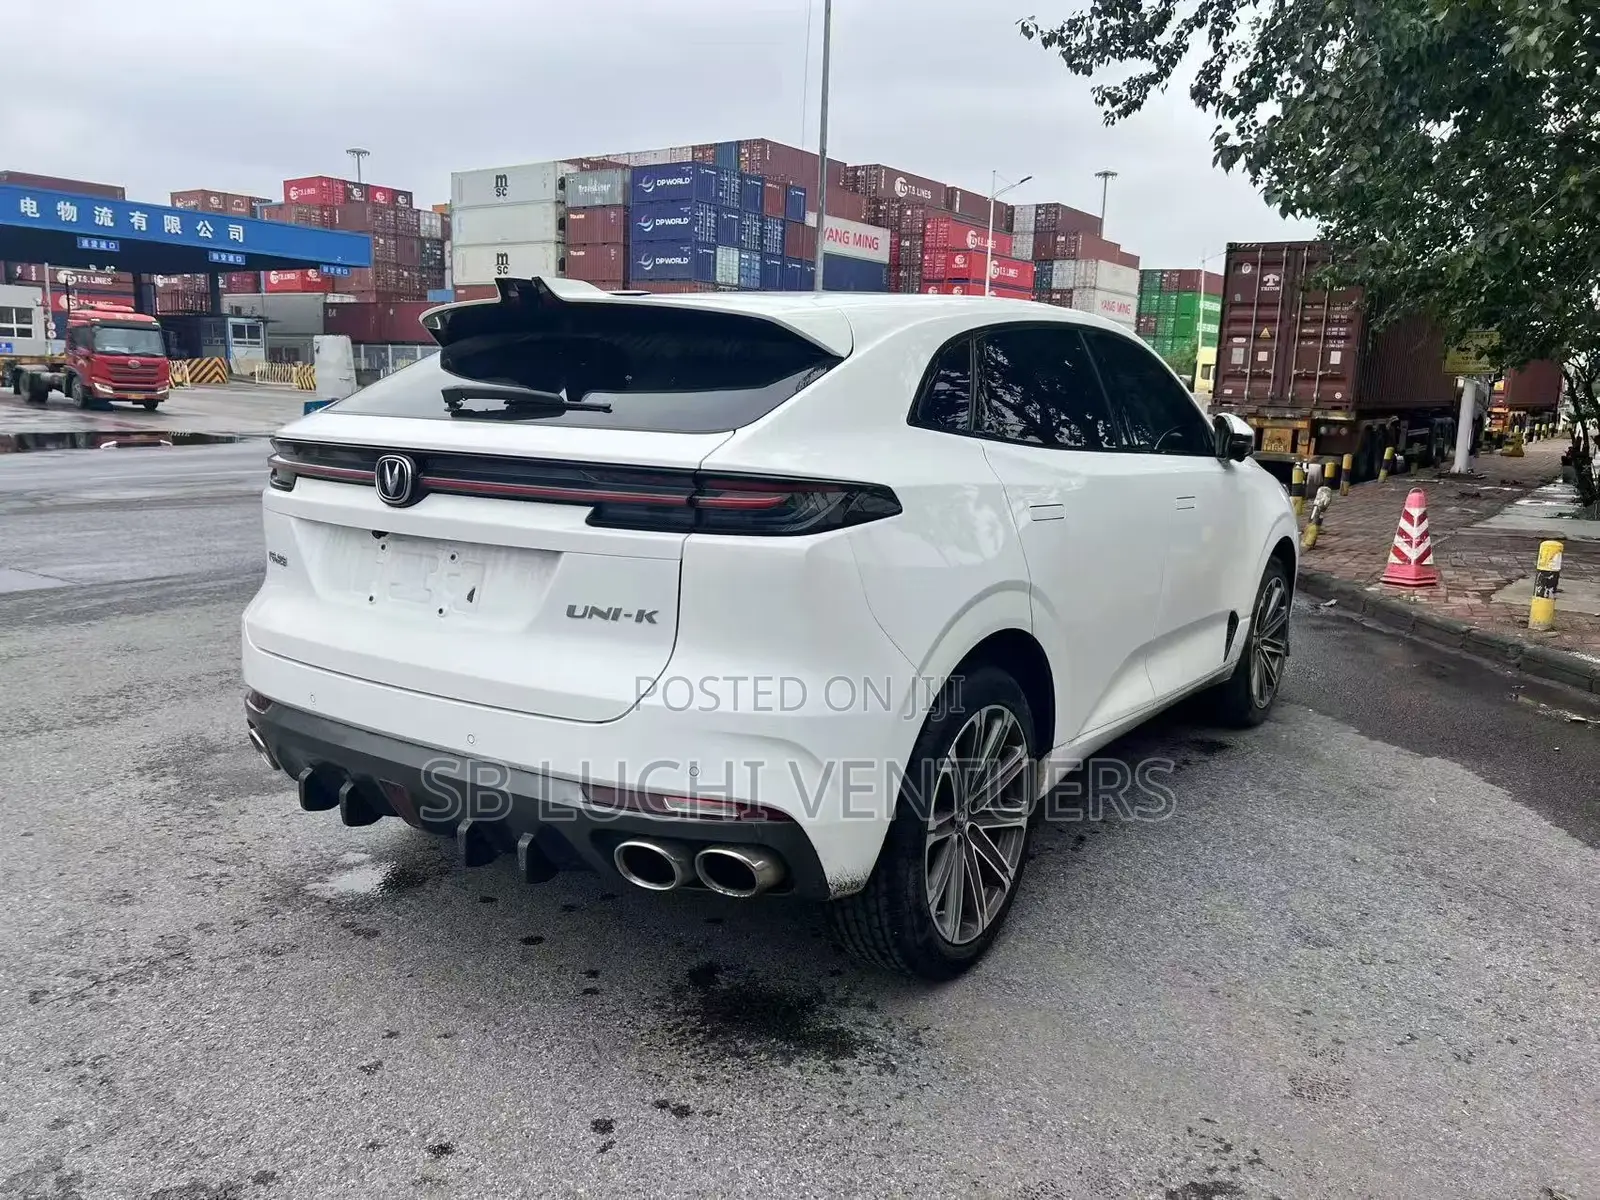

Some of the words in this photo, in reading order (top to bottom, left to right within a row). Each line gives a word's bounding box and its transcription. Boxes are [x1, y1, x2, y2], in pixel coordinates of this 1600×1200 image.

[20, 196, 244, 243] 电物流有限公司
[853, 232, 880, 250] MING
[91, 276, 113, 285] LINES
[566, 604, 660, 624] UNI-K
